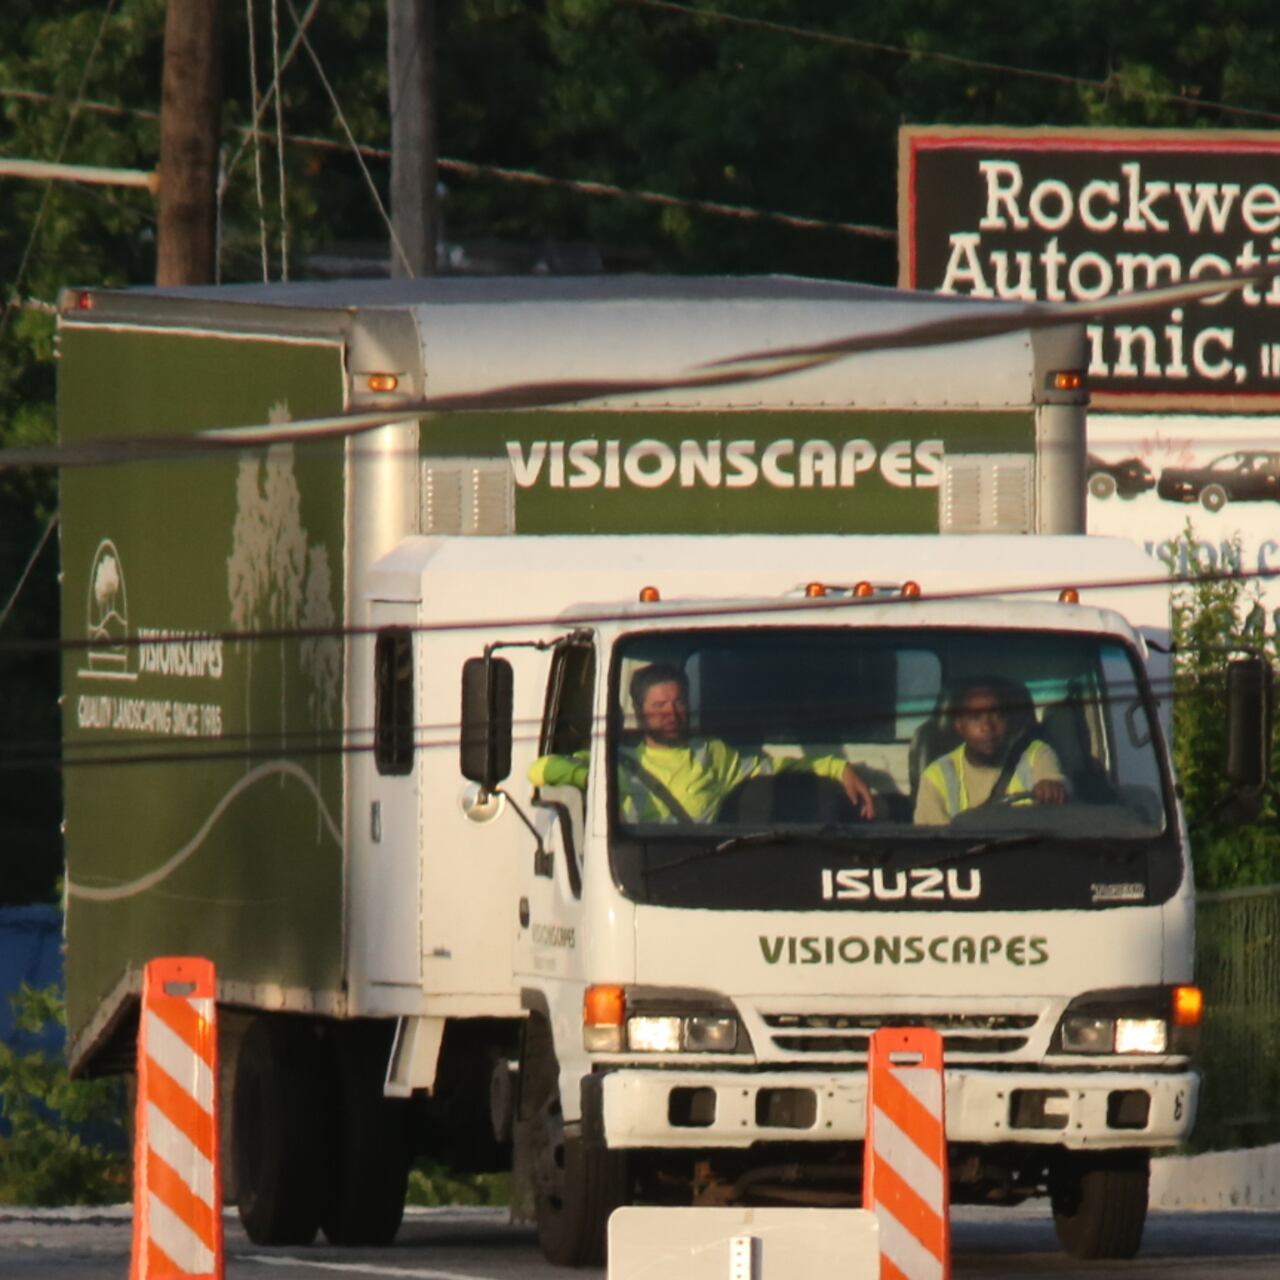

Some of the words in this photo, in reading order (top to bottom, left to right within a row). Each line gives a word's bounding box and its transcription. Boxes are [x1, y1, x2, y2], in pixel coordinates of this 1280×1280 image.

[1086, 307, 1247, 384] inic,
[505, 439, 945, 489] VISIONSCAPES
[1143, 538, 1243, 578] SION
[821, 867, 982, 900] ISUZU
[758, 935, 1050, 967] VISIONSCAPES
